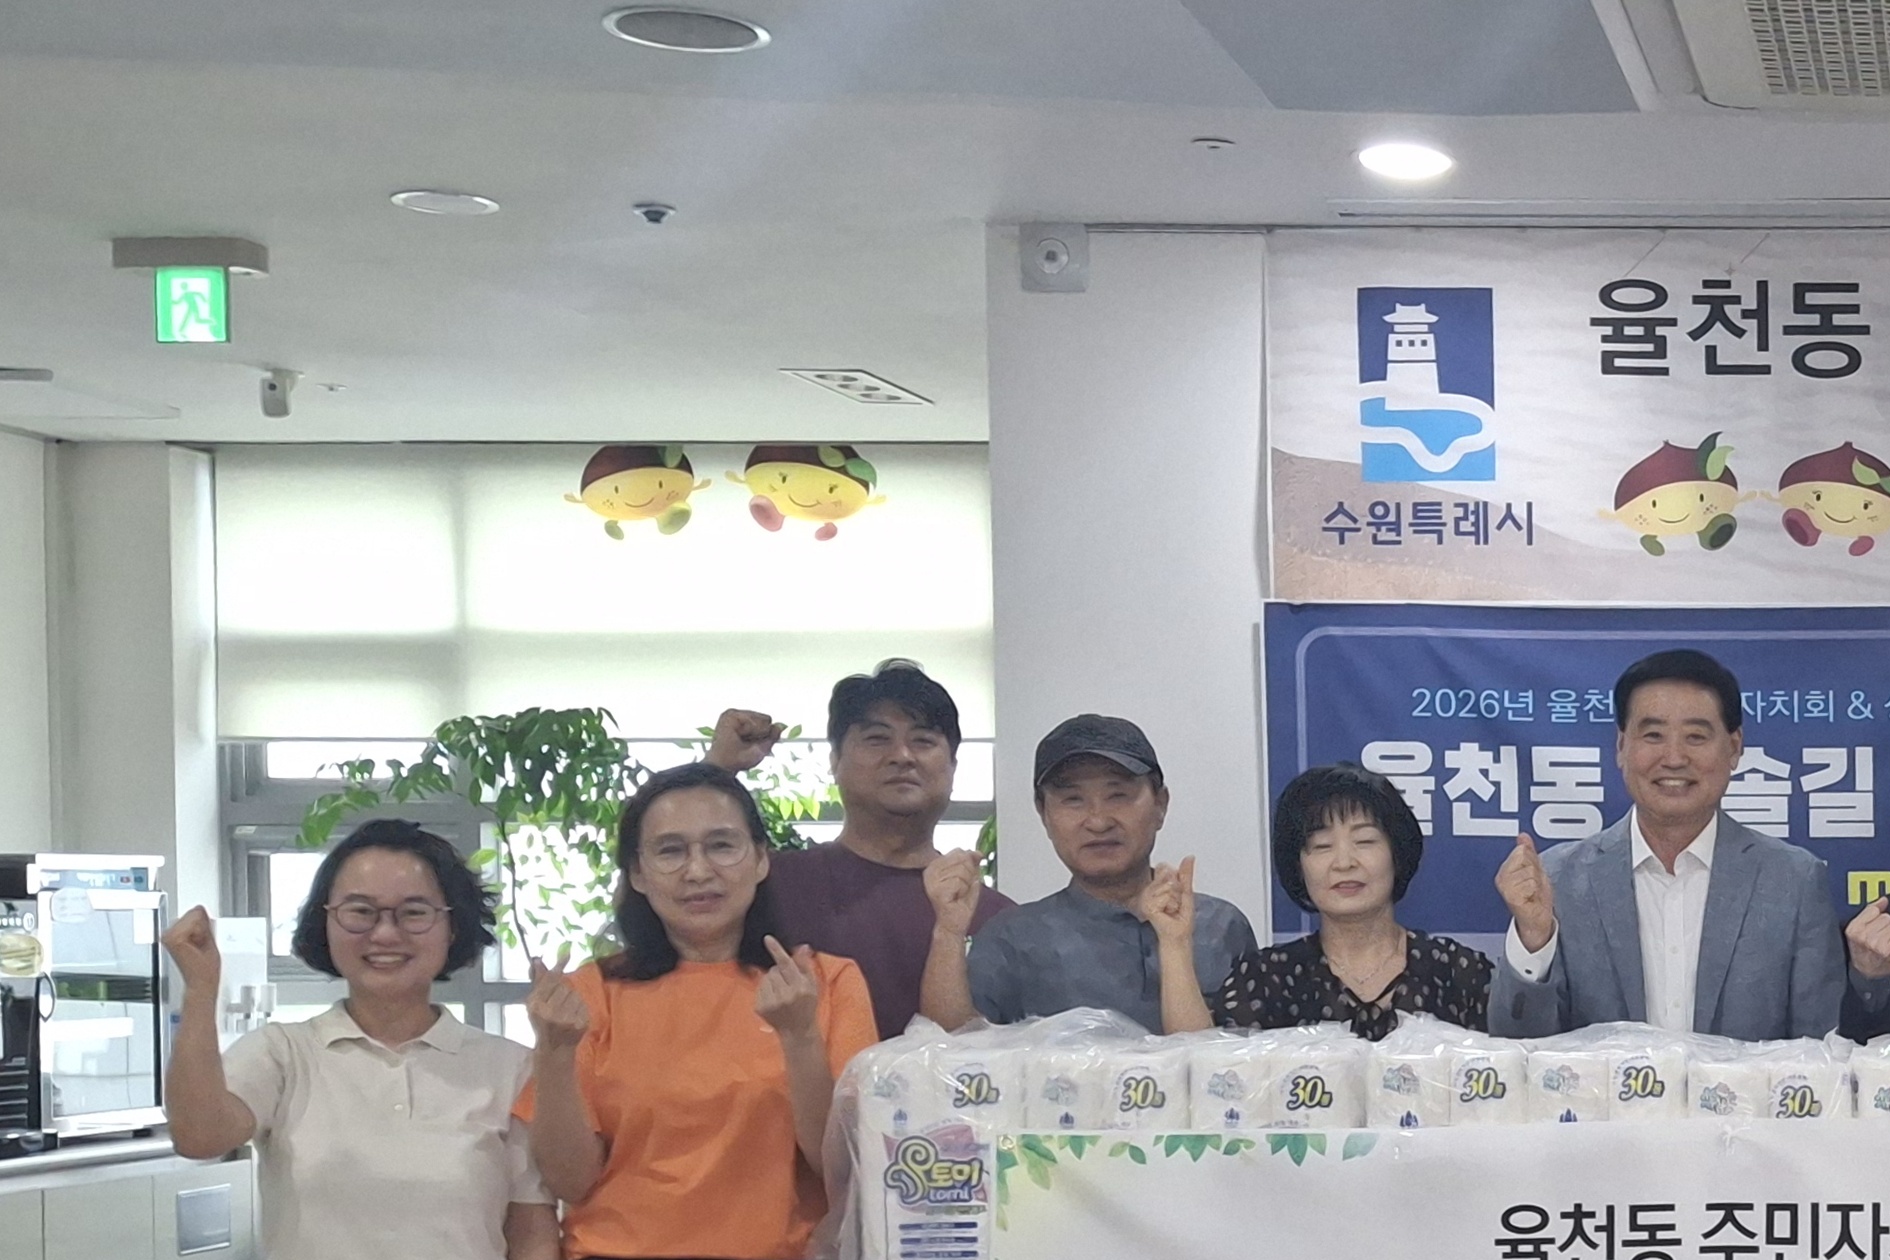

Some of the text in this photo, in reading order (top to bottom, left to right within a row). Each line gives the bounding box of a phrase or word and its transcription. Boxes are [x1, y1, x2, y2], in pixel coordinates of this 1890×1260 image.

[1590, 277, 1872, 378] 율천동
[1321, 499, 1536, 548] 수원특례시
[1411, 687, 1535, 723] 2026년
[1546, 688, 1615, 723] 율천
[1740, 689, 1836, 722] 자치회
[1847, 690, 1875, 719] &
[1720, 745, 1876, 839] 솔길
